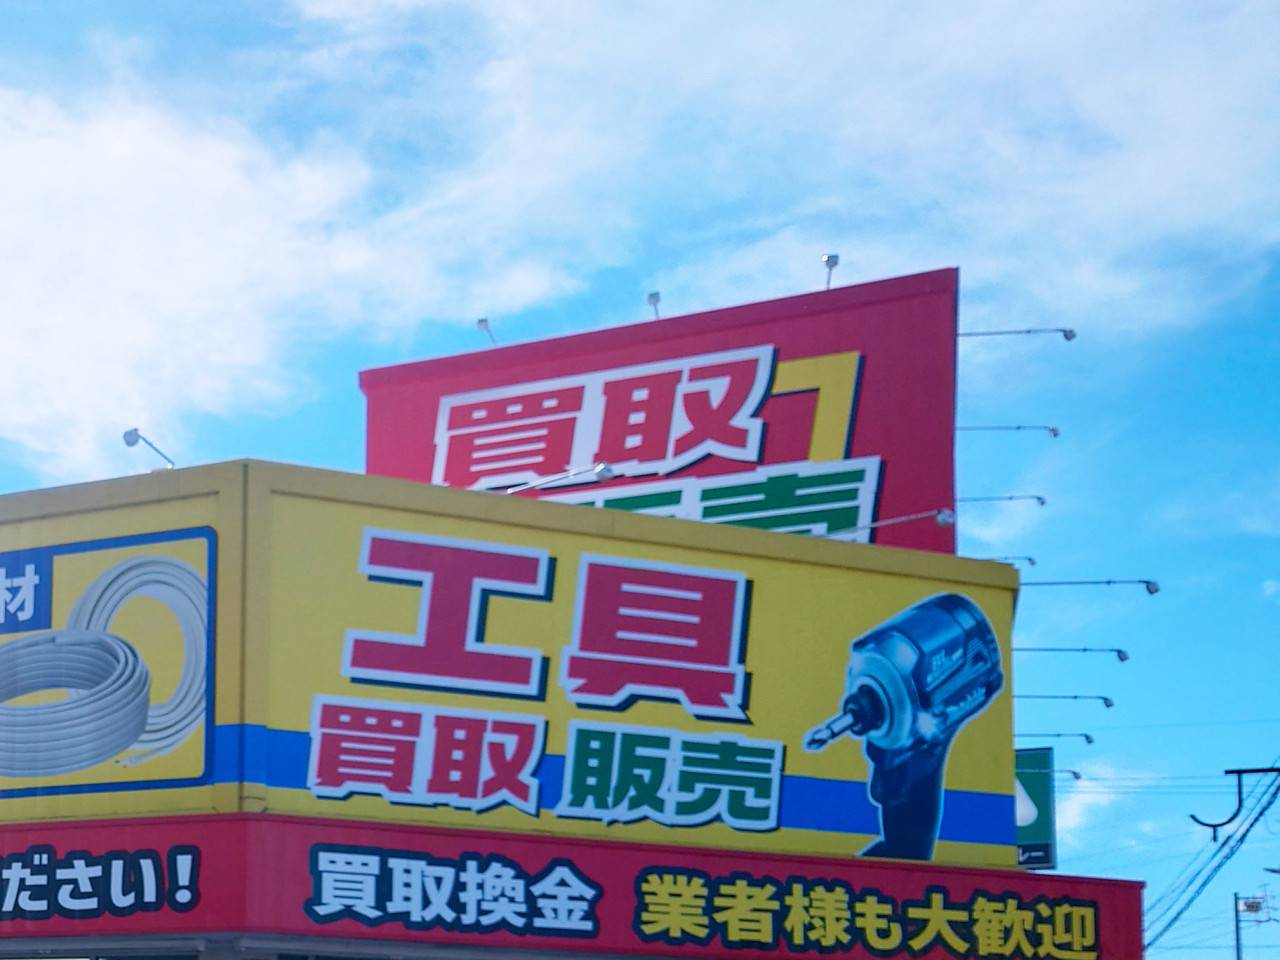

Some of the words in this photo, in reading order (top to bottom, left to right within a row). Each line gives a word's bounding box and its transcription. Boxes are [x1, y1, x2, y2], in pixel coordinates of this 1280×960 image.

[343, 529, 748, 722] 工具
[310, 696, 546, 815] 買取
[556, 720, 785, 831] 販売
[313, 851, 598, 932] 買取換金
